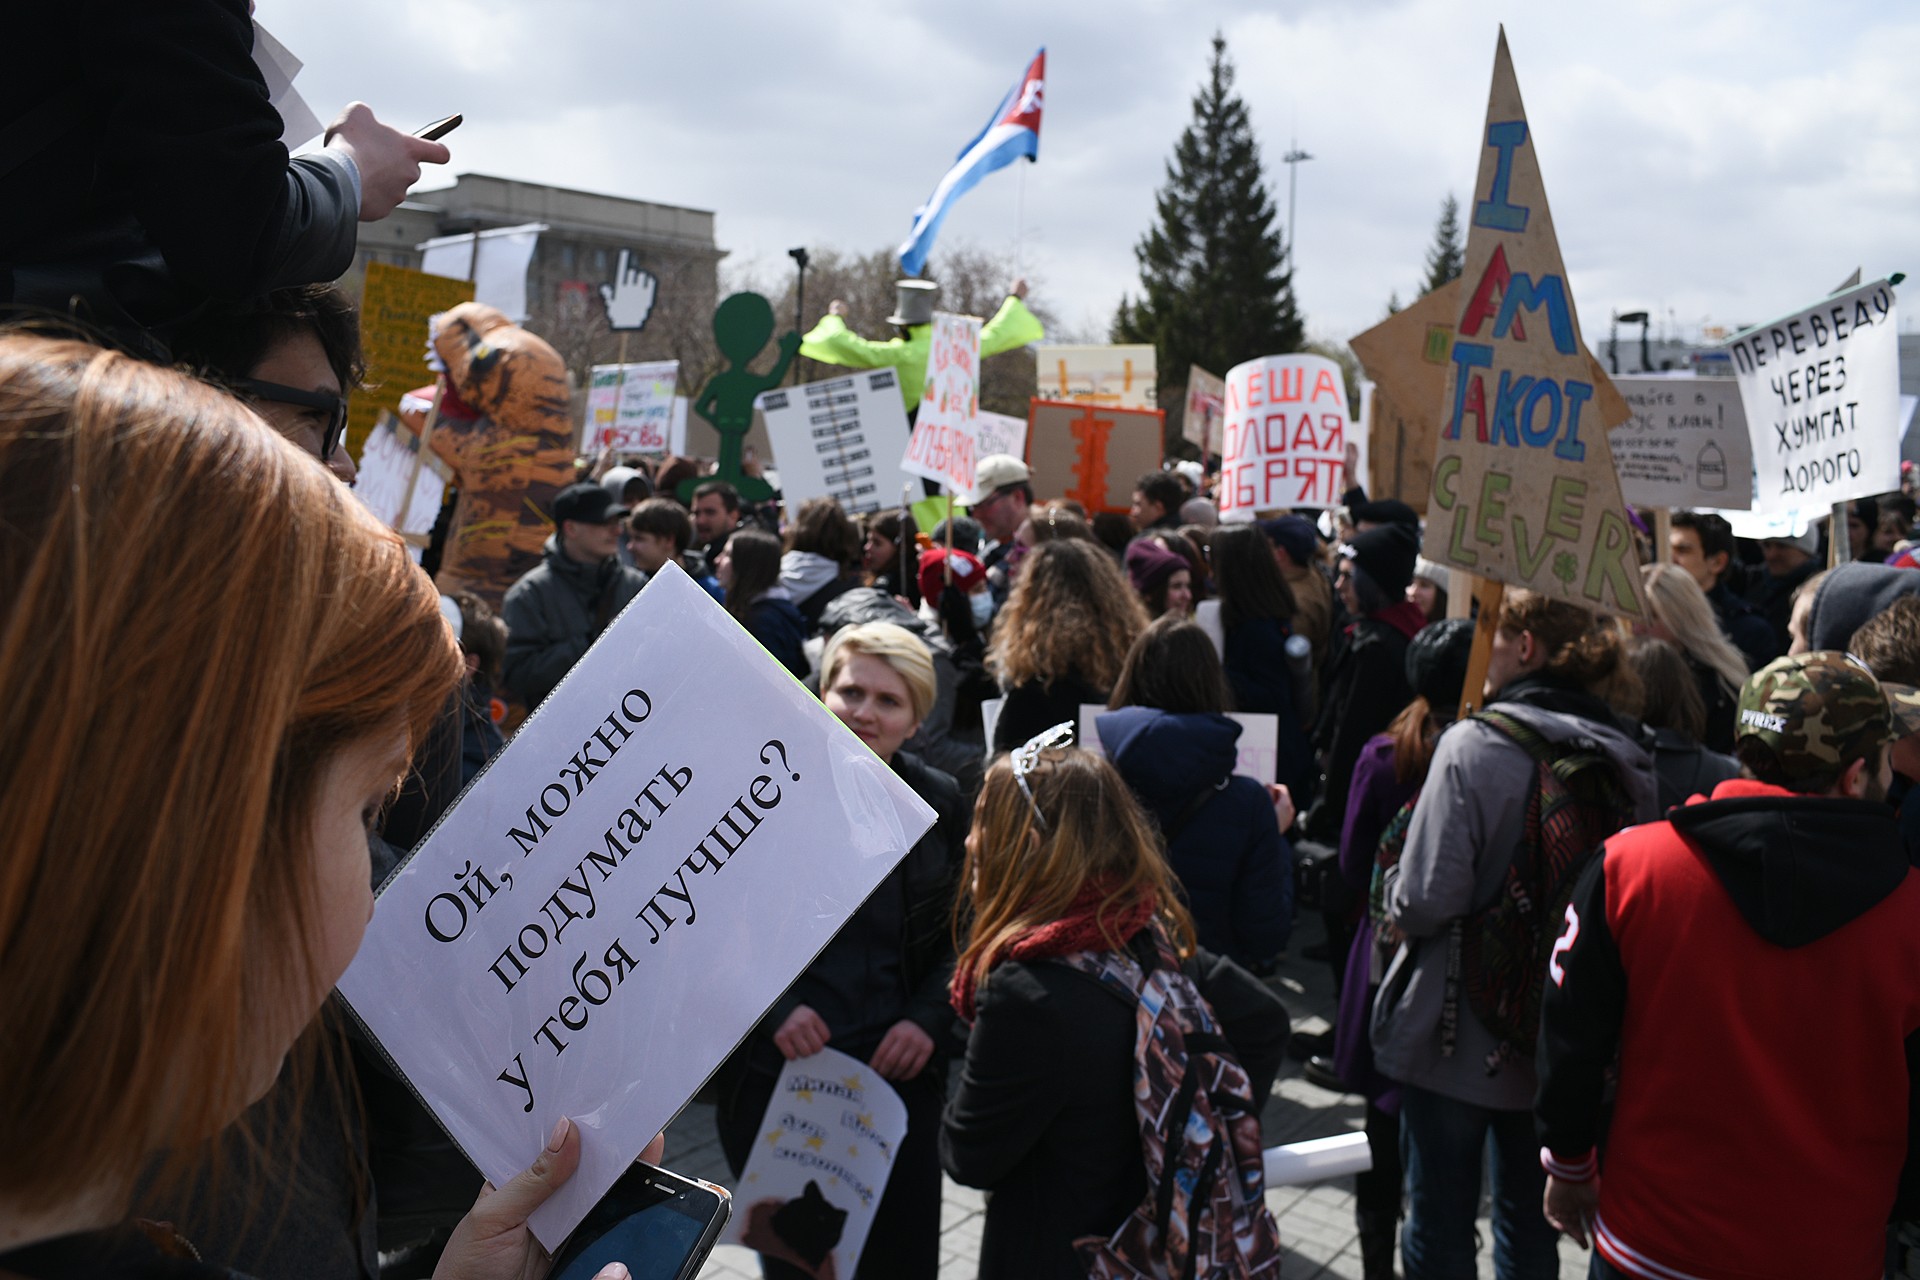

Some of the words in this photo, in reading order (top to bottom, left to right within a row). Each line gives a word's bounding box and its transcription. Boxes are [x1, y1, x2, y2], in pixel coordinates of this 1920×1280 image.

[1473, 120, 1530, 233] I
[1459, 242, 1578, 355] AM
[1732, 288, 1890, 374] ПЕРЕВЕДУ
[1442, 341, 1593, 462] TAKOI
[1771, 356, 1846, 406] ЧЕРЕЗ
[1774, 402, 1858, 453] ХУМГАТ
[1780, 449, 1861, 494] ДОРОГО
[1433, 455, 1641, 614] CLEVER
[425, 860, 514, 943] Ой,
[505, 689, 652, 858] можно
[487, 763, 693, 994] подумать
[497, 1053, 535, 1113] у
[533, 938, 640, 1057] тебя
[635, 739, 801, 945] лучше?
